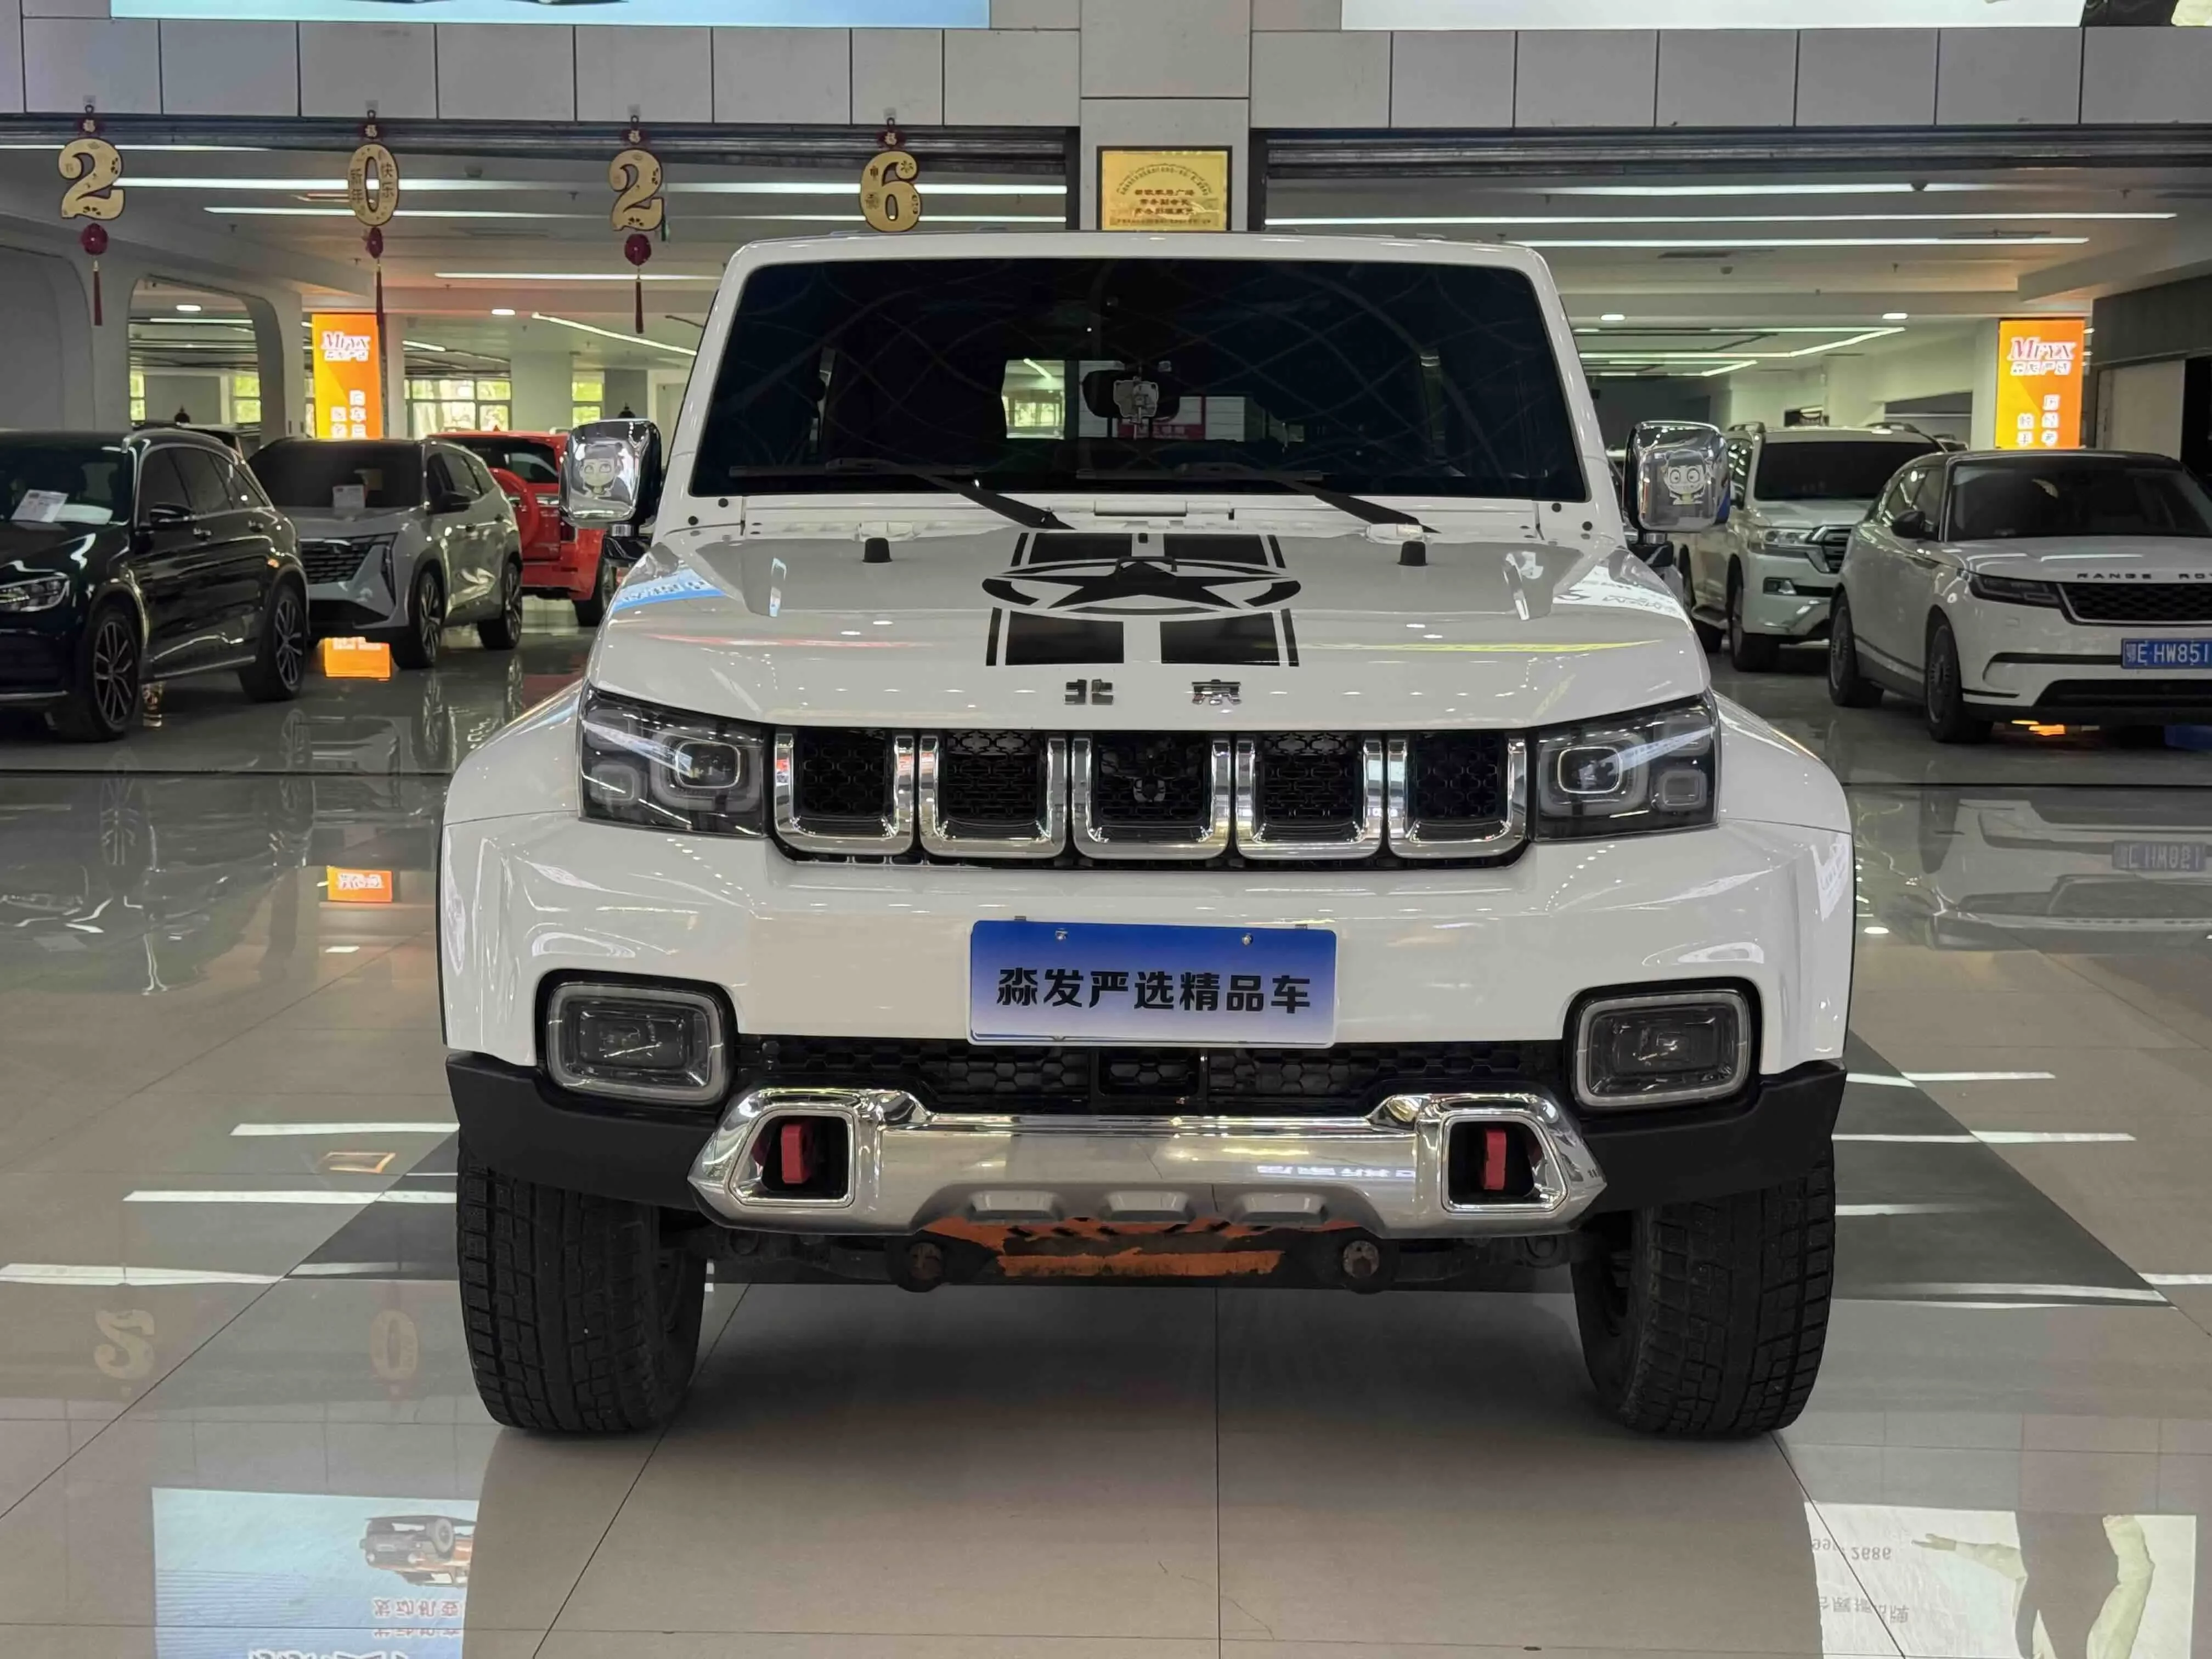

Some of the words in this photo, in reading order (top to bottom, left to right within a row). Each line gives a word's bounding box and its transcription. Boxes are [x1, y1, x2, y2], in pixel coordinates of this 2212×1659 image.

[58, 138, 126, 221] 2
[348, 144, 398, 226] 0
[608, 149, 663, 232] 2
[859, 150, 922, 232] 6
[996, 967, 1311, 1014] 淼发严选精品车
